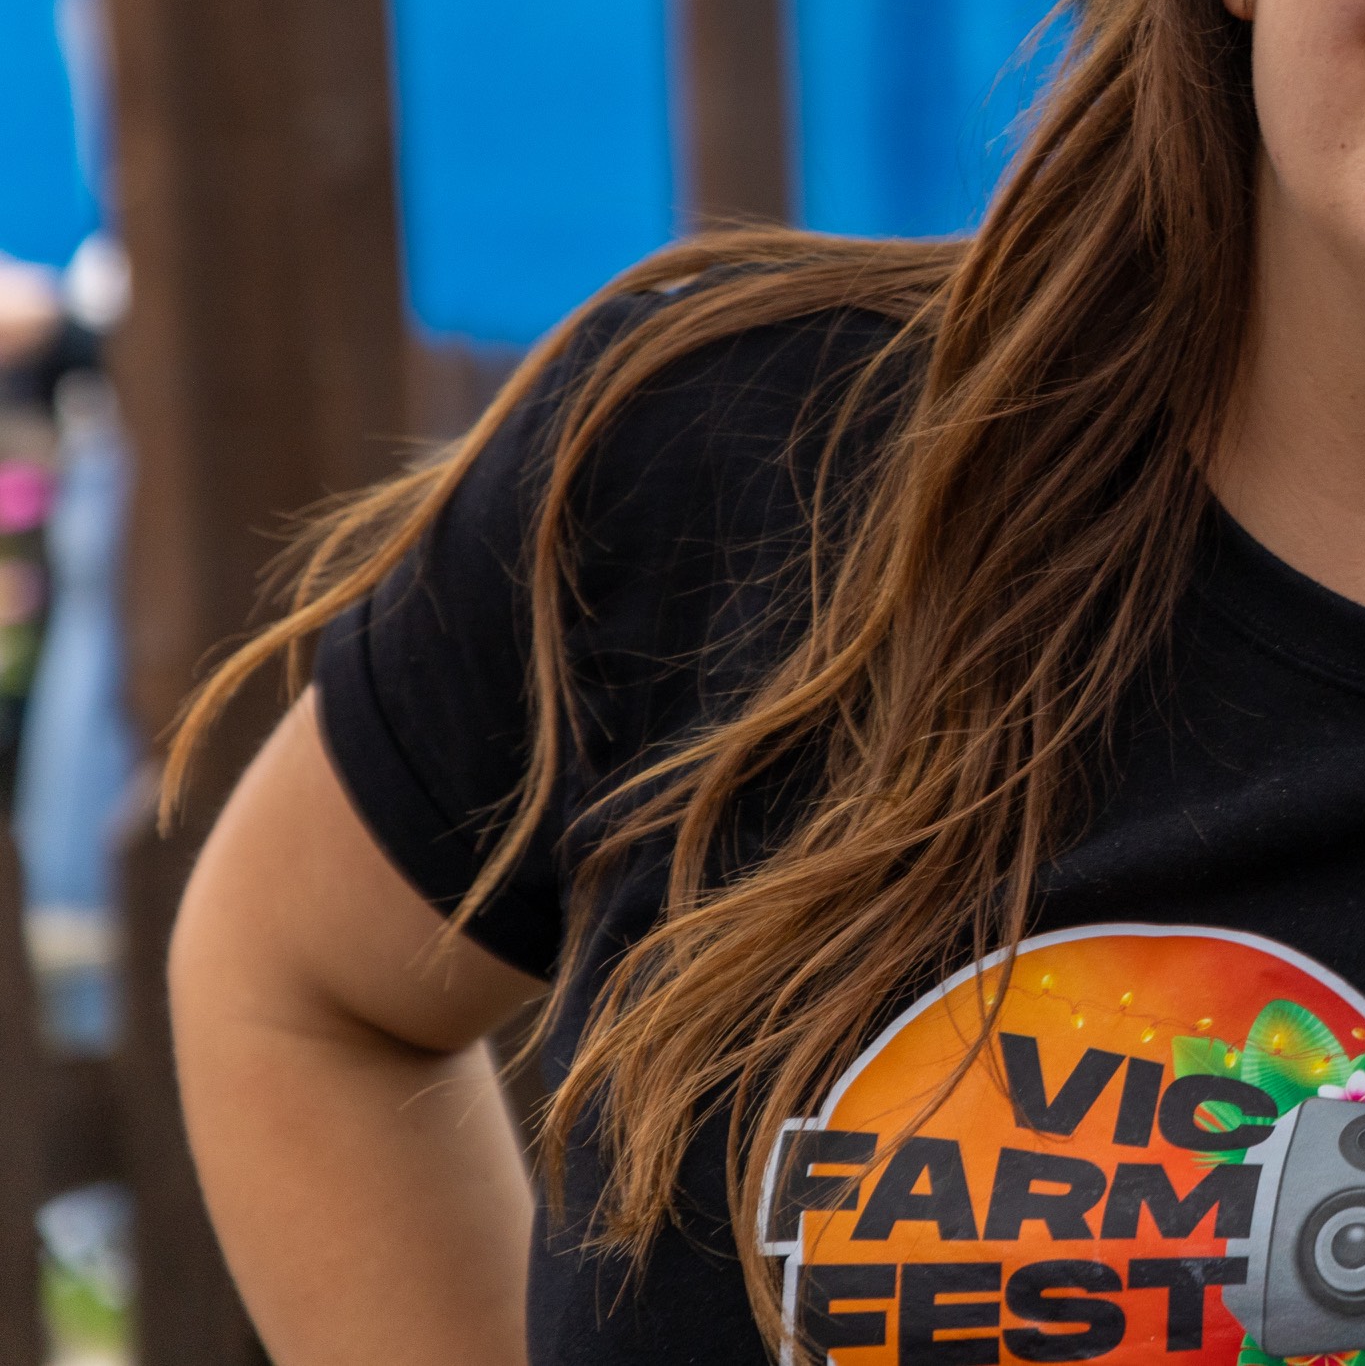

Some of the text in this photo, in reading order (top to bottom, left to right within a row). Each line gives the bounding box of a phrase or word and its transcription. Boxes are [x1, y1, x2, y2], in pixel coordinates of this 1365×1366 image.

[997, 1031, 1280, 1153] VIC
[763, 1128, 1265, 1242] FARM
[788, 1256, 1250, 1365] FEST
